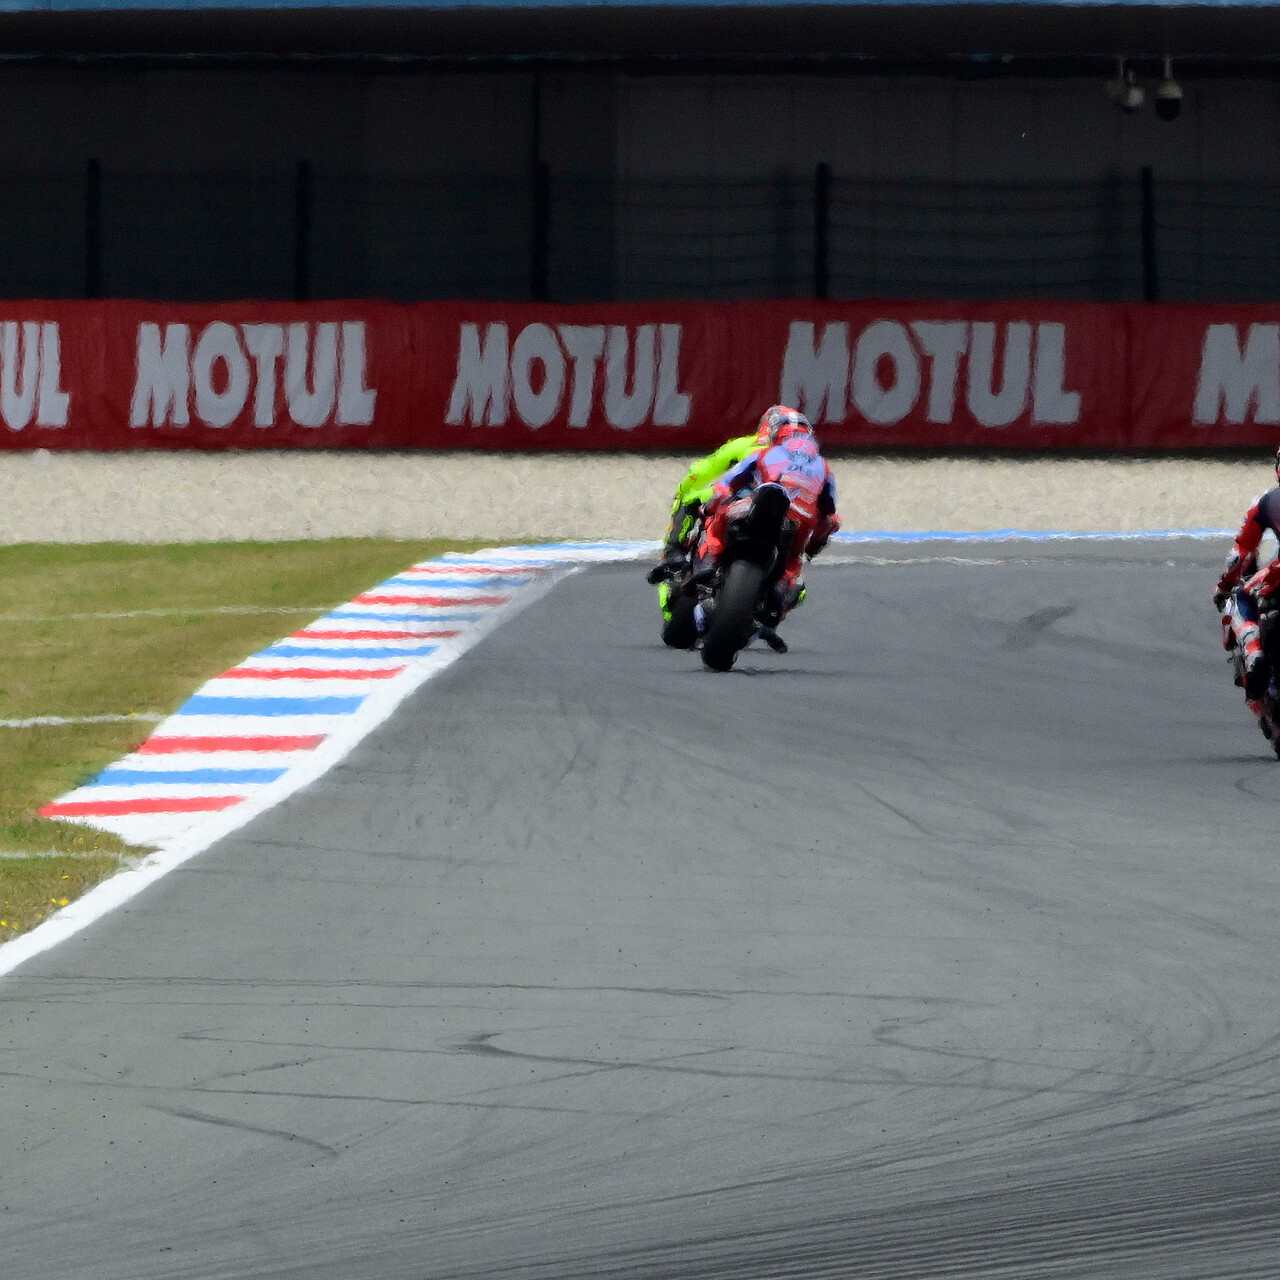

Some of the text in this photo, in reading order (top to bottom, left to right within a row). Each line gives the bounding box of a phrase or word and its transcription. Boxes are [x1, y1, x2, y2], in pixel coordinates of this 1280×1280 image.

[129, 320, 377, 429] MOTUL
[444, 321, 691, 430] MOTUL
[781, 320, 1081, 427] MOTUL
